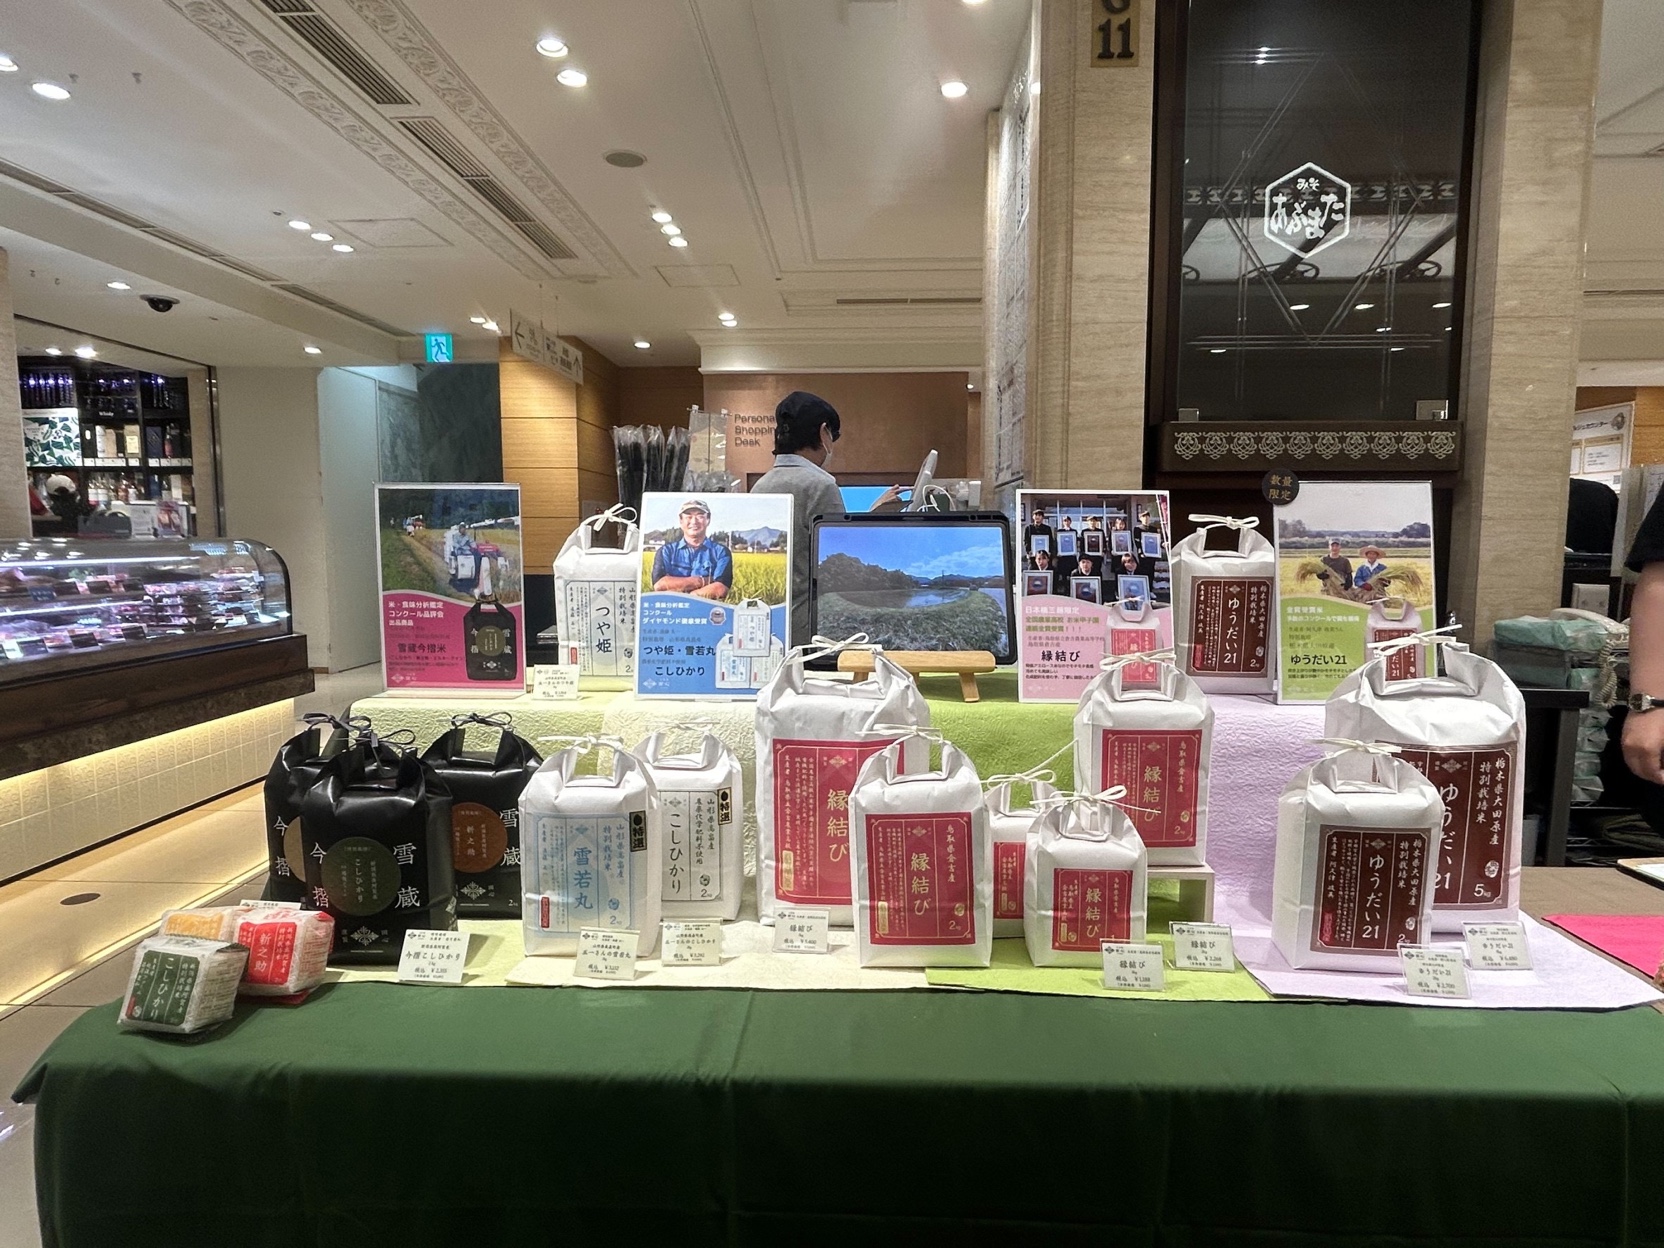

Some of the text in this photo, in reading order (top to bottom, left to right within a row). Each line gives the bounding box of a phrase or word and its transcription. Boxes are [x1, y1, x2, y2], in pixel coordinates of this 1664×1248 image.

[1097, 18, 1135, 59] 11
[1296, 177, 1321, 191] みそ
[734, 413, 776, 424] Persona
[734, 425, 776, 437] Shoppin
[734, 437, 761, 447] Desk
[595, 605, 613, 653] つや姫
[643, 645, 716, 656] つや姫・雪若丸
[1223, 597, 1240, 664] ゆうだい21
[655, 666, 705, 676] こしひかり
[1041, 650, 1081, 662] 縁結び
[1290, 655, 1347, 665] ゆうだい21
[1143, 765, 1163, 822] 縁結び
[1475, 761, 1492, 824] 特別栽培米
[1489, 757, 1506, 846] 栃木県大田原産
[500, 808, 521, 867] 雪蔵
[826, 788, 849, 863] 縁結び
[310, 842, 329, 909] 今摺
[393, 842, 421, 909] 雪蔵
[573, 846, 594, 910] 雪若丸
[669, 813, 685, 894] こしひかり
[946, 824, 957, 883] 鳥取県倉吉産
[1397, 841, 1410, 889] 特別栽培米
[1408, 838, 1423, 906] 栃木県大田原産
[355, 859, 364, 903] こしひかり
[910, 852, 931, 916] 縁結び
[1361, 854, 1385, 939] ゆうだい21
[790, 924, 813, 932] 縁結び
[1085, 887, 1102, 938] 縁結び
[253, 933, 271, 972] 新之助
[1119, 960, 1146, 969] 縁結び
[1191, 940, 1216, 949] 縁結び
[150, 957, 175, 1020] こしひかり
